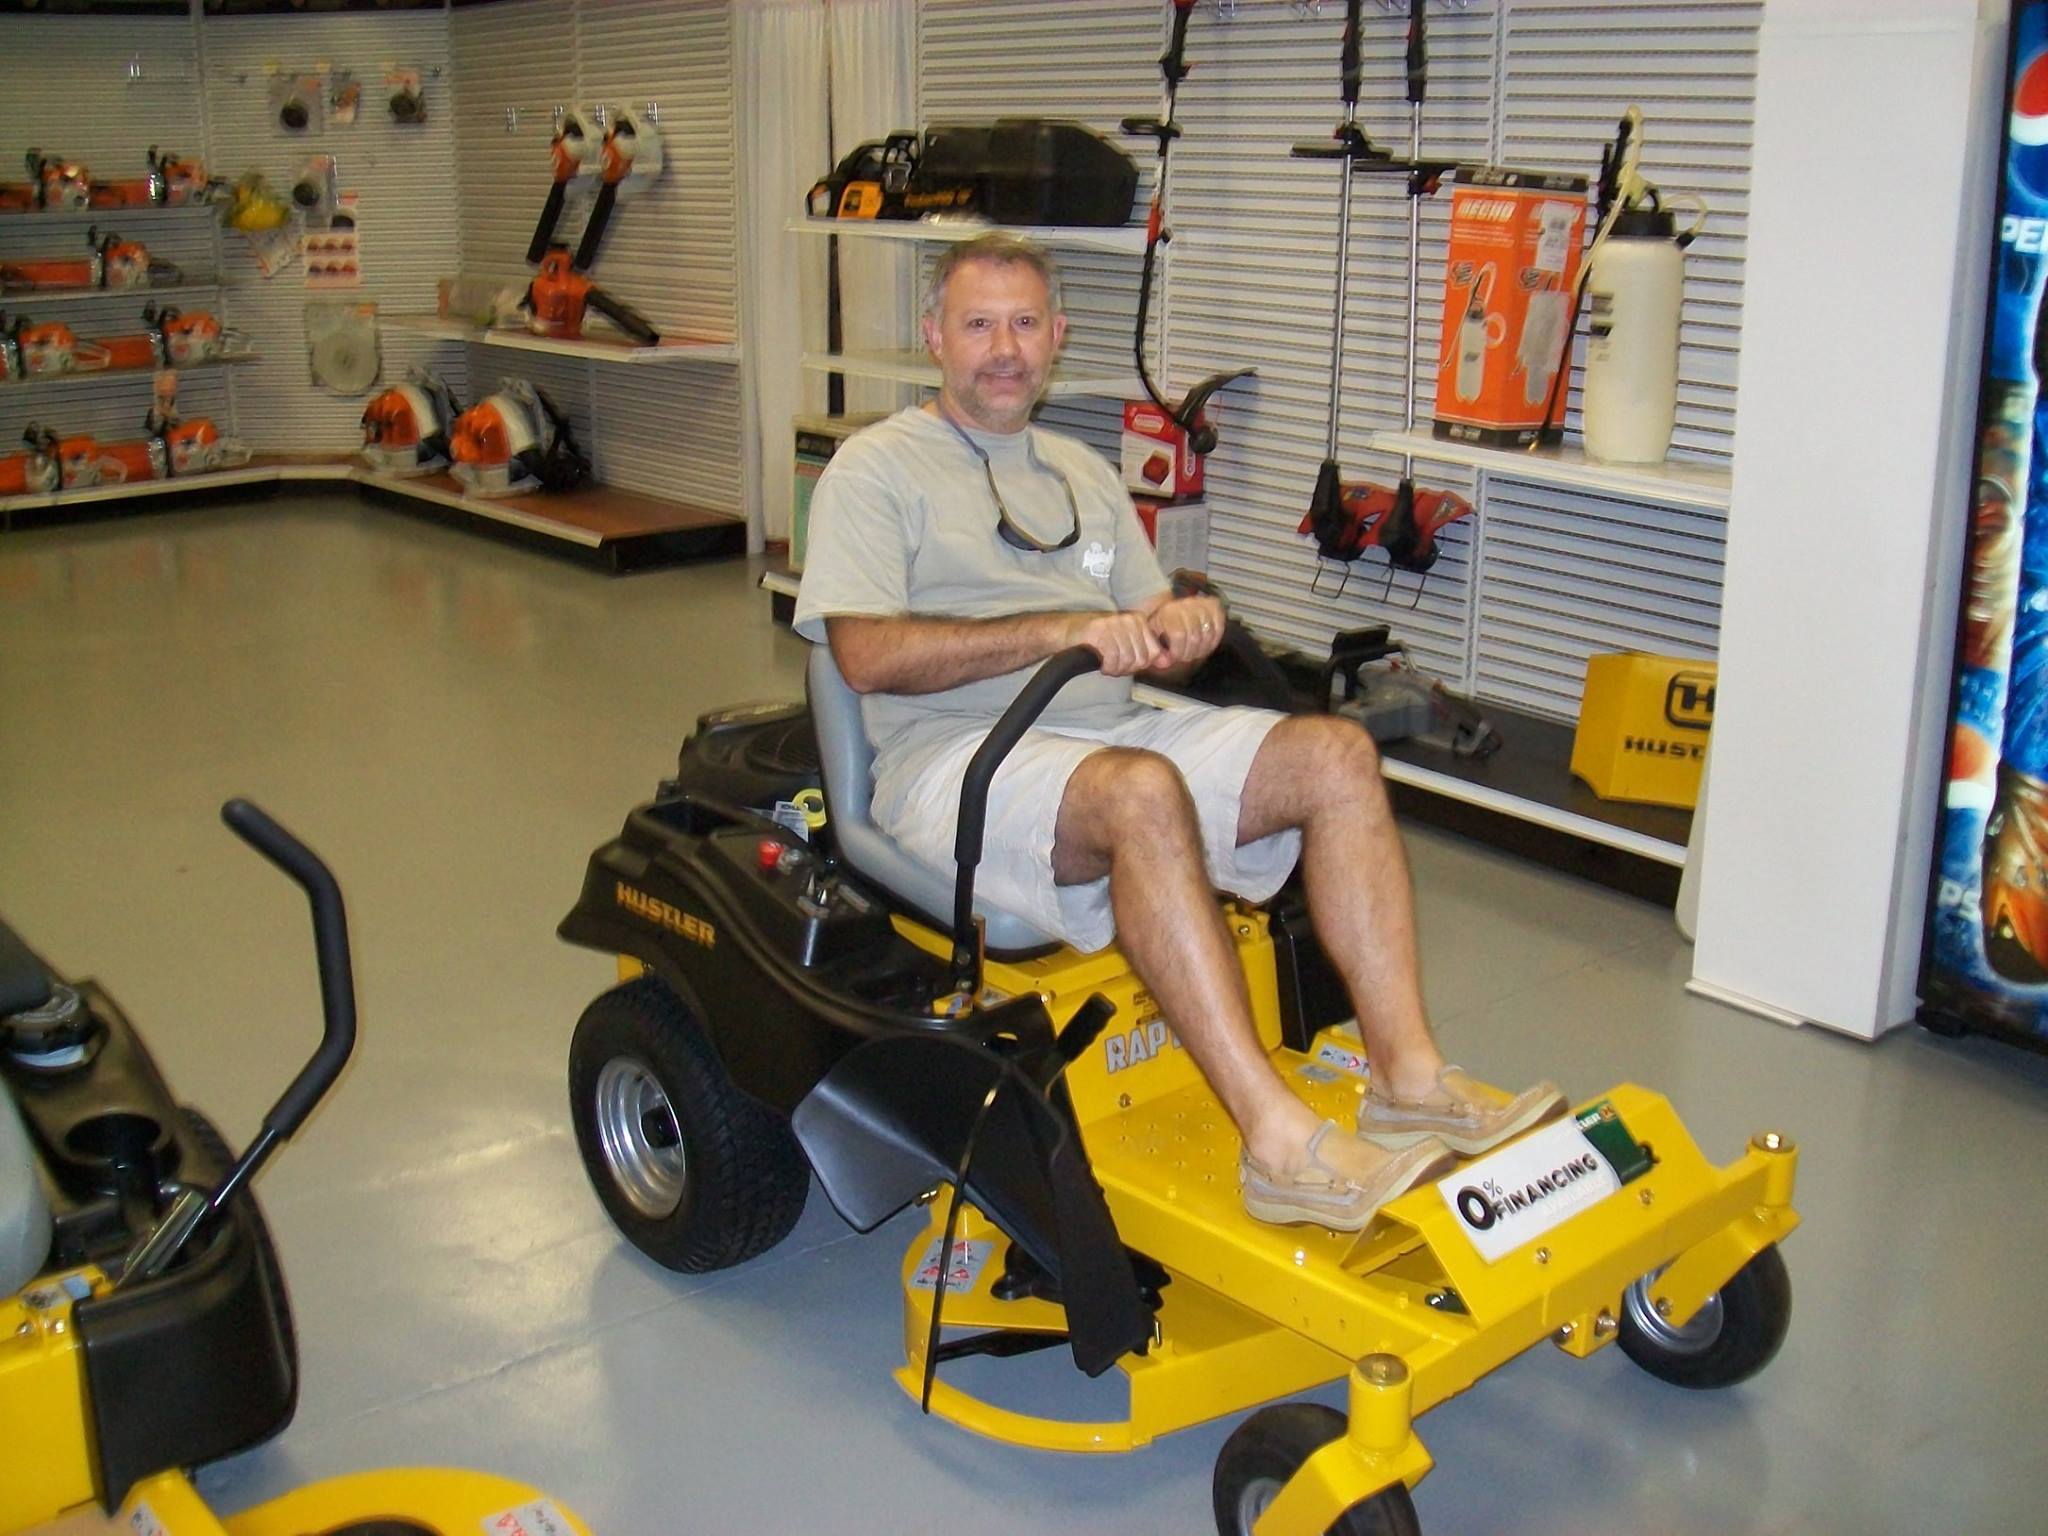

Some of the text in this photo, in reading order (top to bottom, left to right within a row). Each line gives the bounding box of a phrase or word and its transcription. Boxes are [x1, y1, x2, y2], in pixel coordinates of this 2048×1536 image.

[2001, 214, 2048, 253] PE
[616, 880, 716, 949] HUSTLER
[1491, 1153, 1598, 1221] FINANCING
